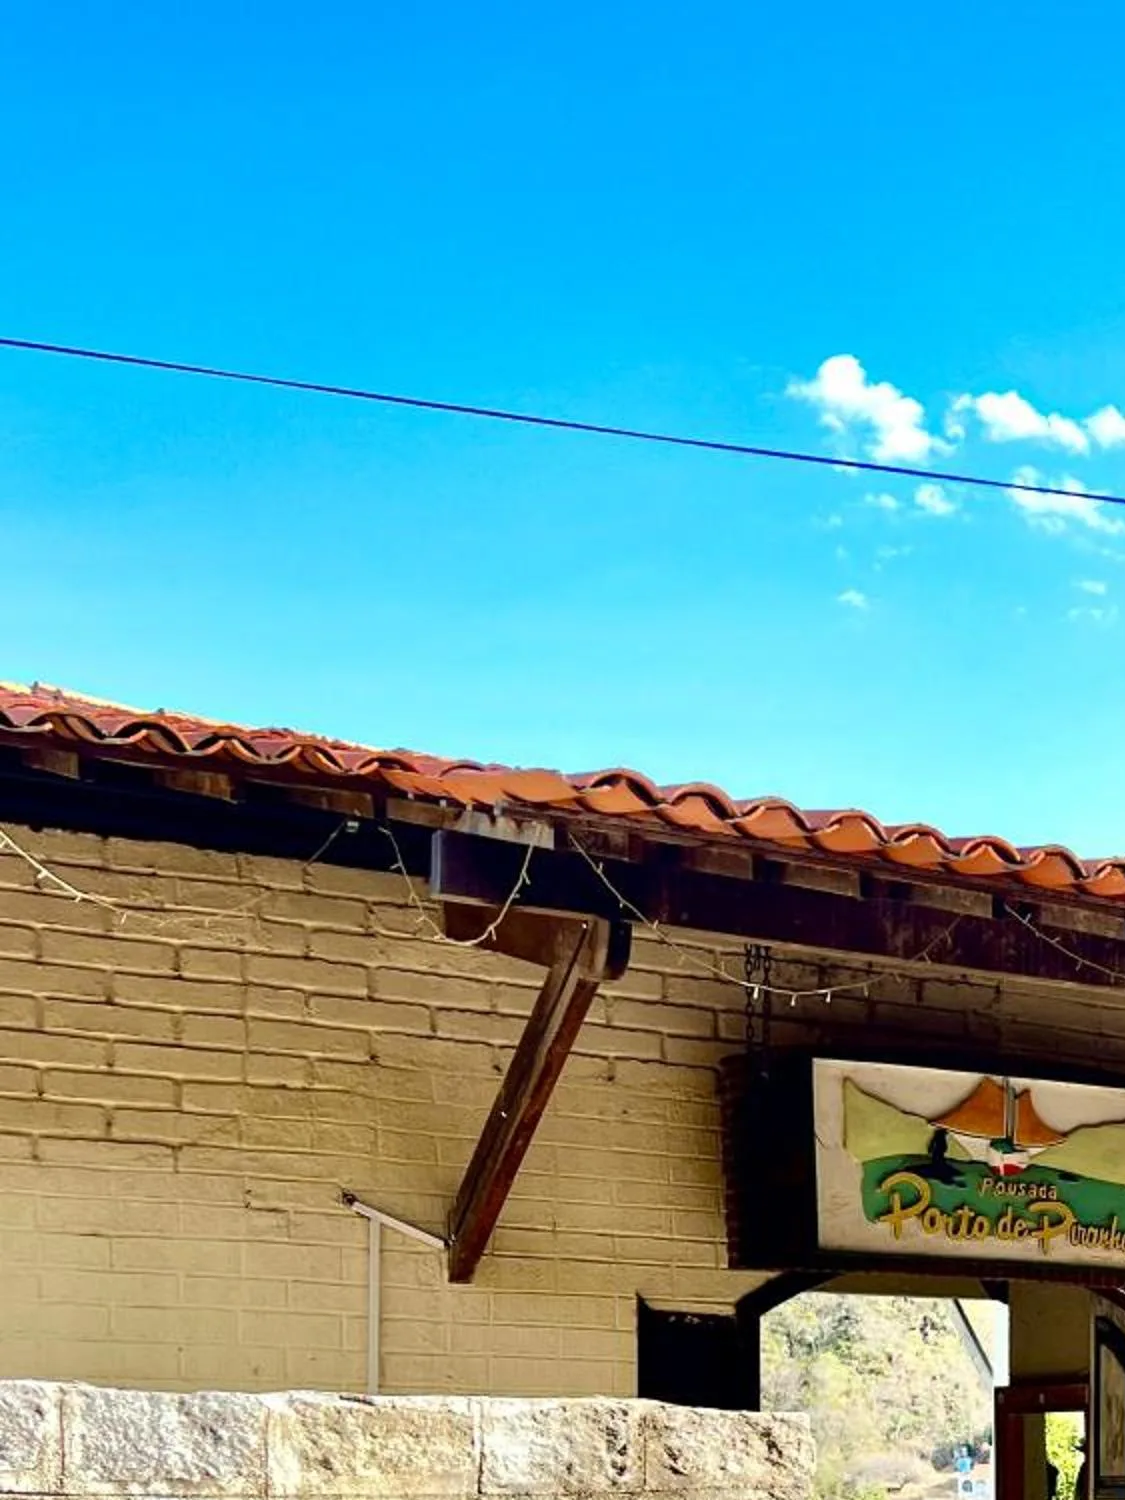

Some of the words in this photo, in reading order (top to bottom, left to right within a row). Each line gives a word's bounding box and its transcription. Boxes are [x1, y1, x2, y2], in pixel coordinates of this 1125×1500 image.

[879, 1171, 990, 1241] Porto
[998, 1205, 1028, 1241] de
[979, 1177, 1057, 1200] Pousada
